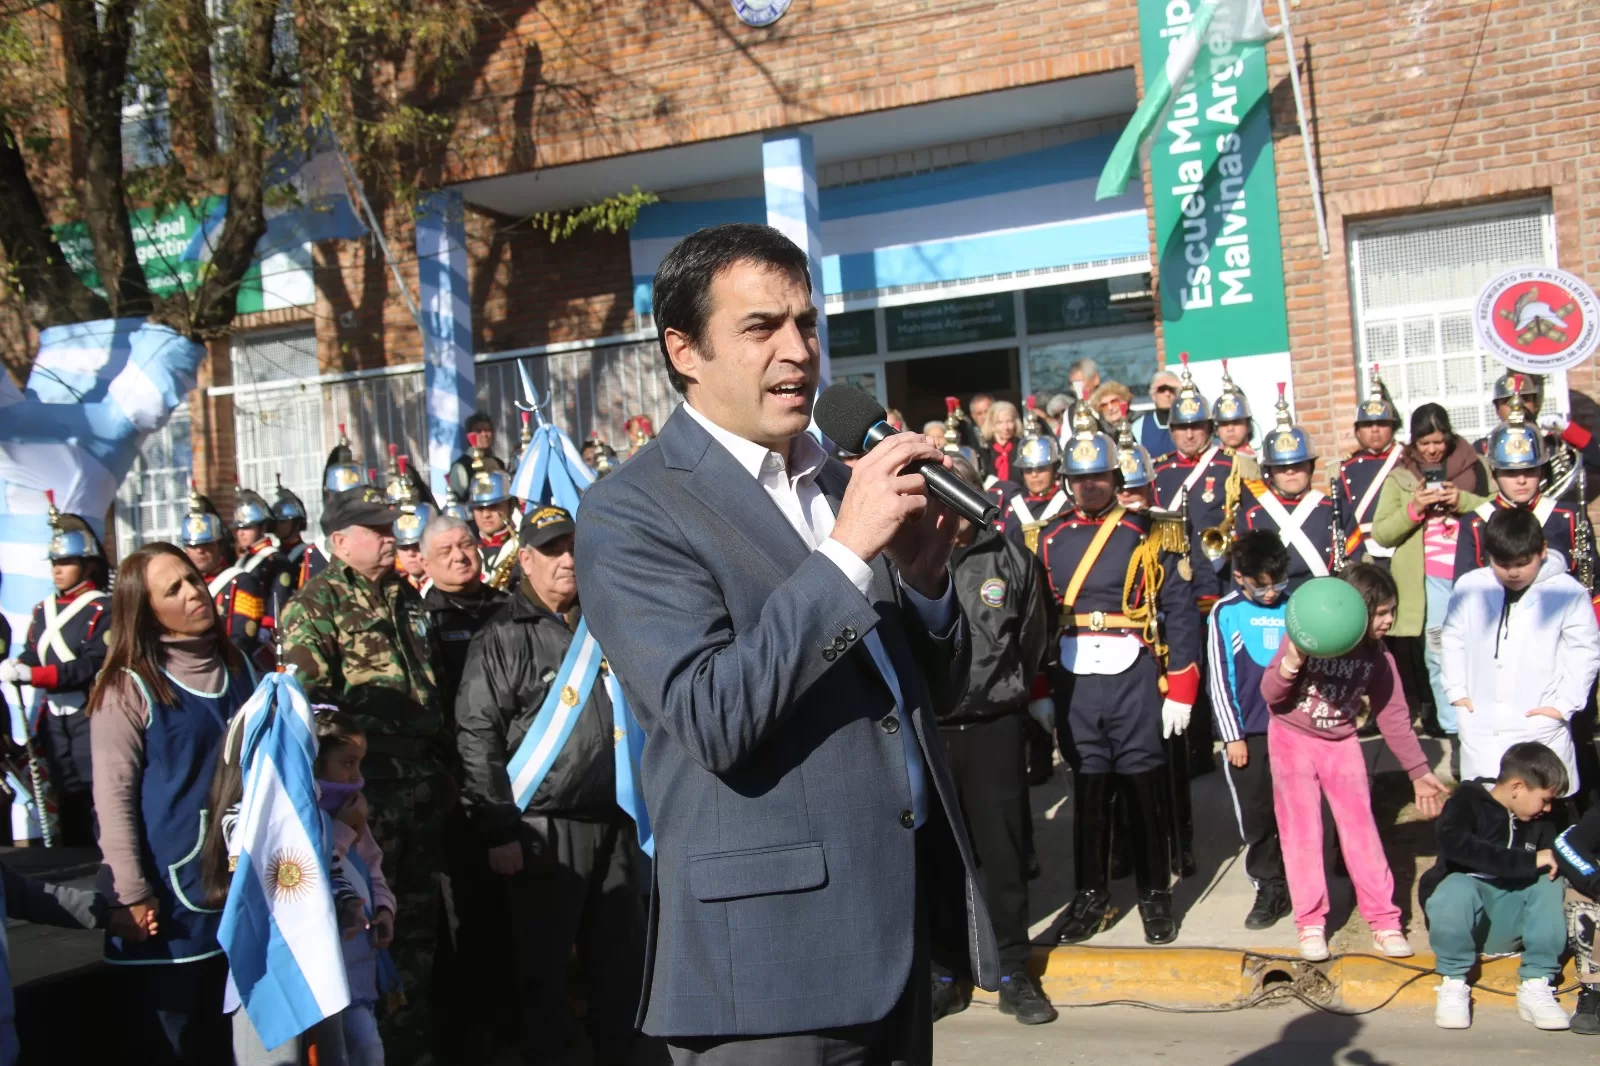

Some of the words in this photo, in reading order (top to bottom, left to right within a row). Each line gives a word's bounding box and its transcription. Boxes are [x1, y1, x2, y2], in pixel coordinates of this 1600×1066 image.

[1172, 160, 1213, 310] Escuela
[1214, 132, 1254, 305] Malvinas
[898, 321, 943, 334] Malvinas
[944, 314, 1003, 329] Argentinas
